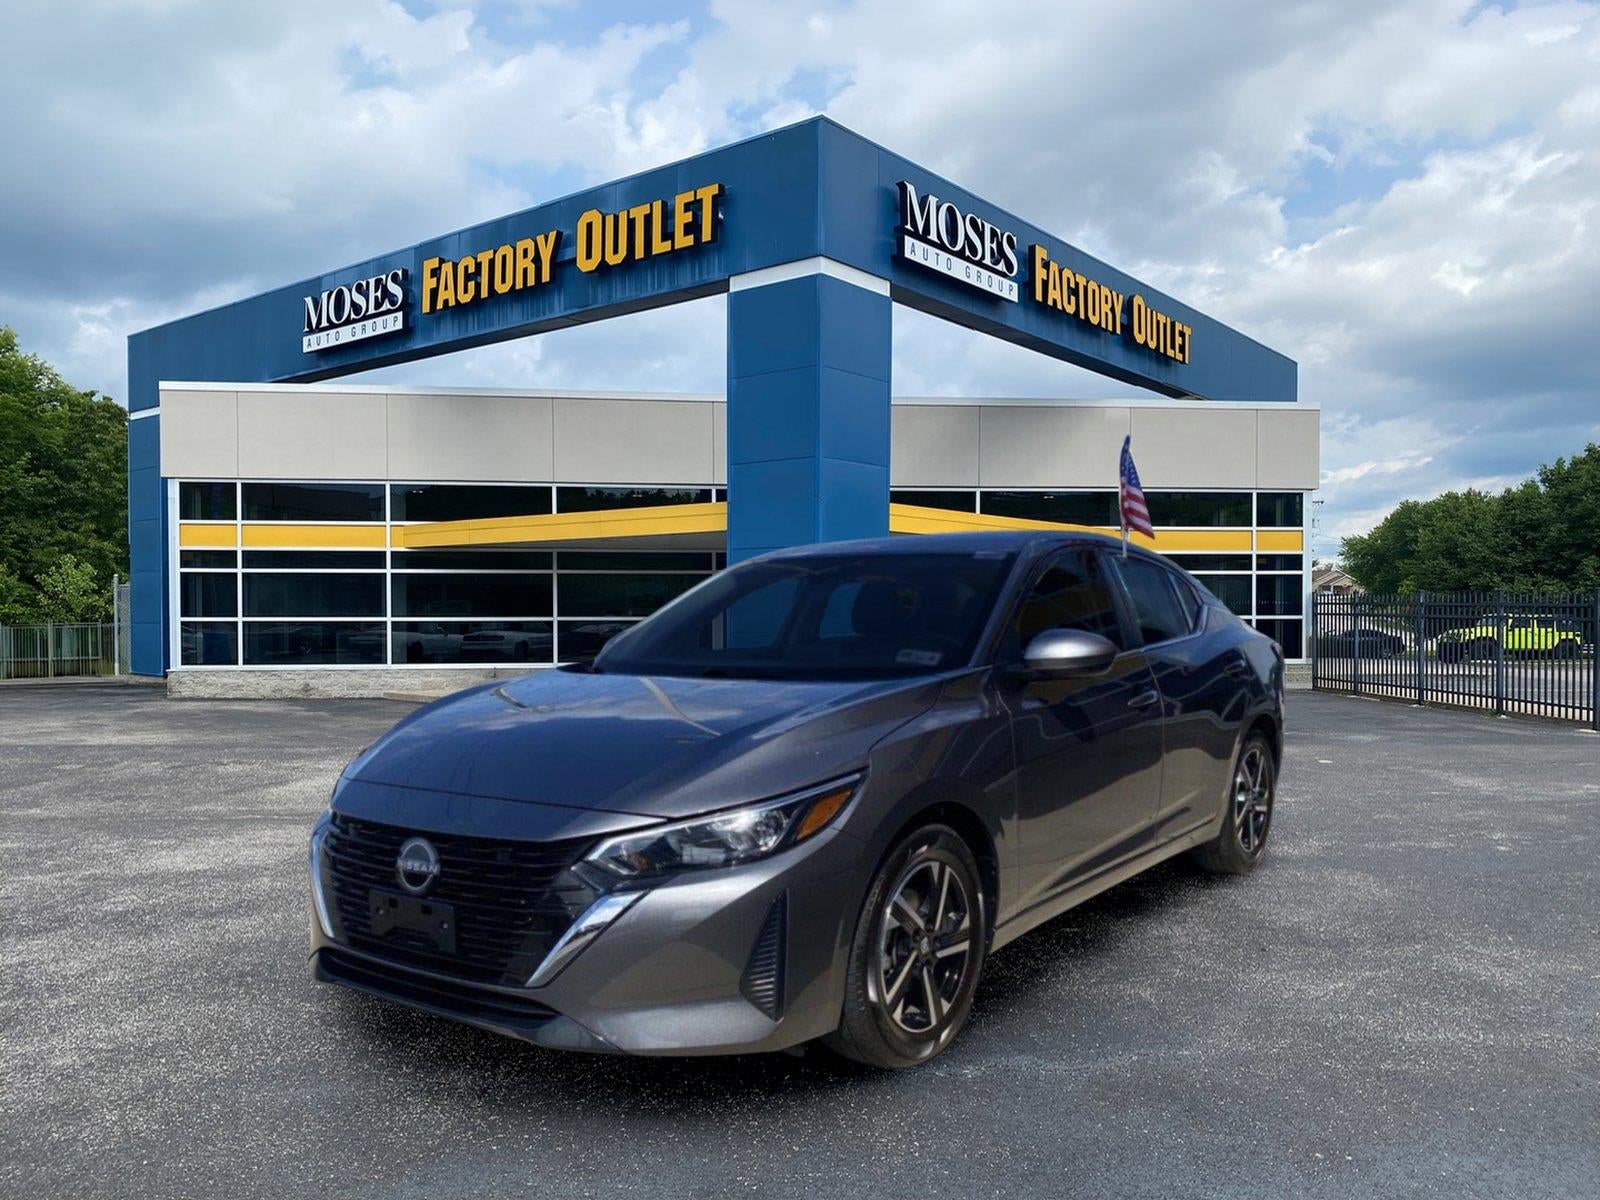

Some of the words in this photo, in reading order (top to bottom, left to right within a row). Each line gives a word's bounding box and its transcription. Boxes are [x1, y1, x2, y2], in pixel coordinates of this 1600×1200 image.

[422, 230, 558, 314] FACTORY
[576, 183, 720, 273] OUTLET
[904, 181, 1018, 277] MOSES
[910, 242, 953, 271] AUTO
[965, 265, 1015, 295] GROUP
[303, 270, 403, 333] MOSES
[307, 331, 341, 350] AUTO
[350, 315, 400, 338] GROUP
[1034, 244, 1124, 335] FACTORY
[1132, 294, 1192, 364] OUTLET
